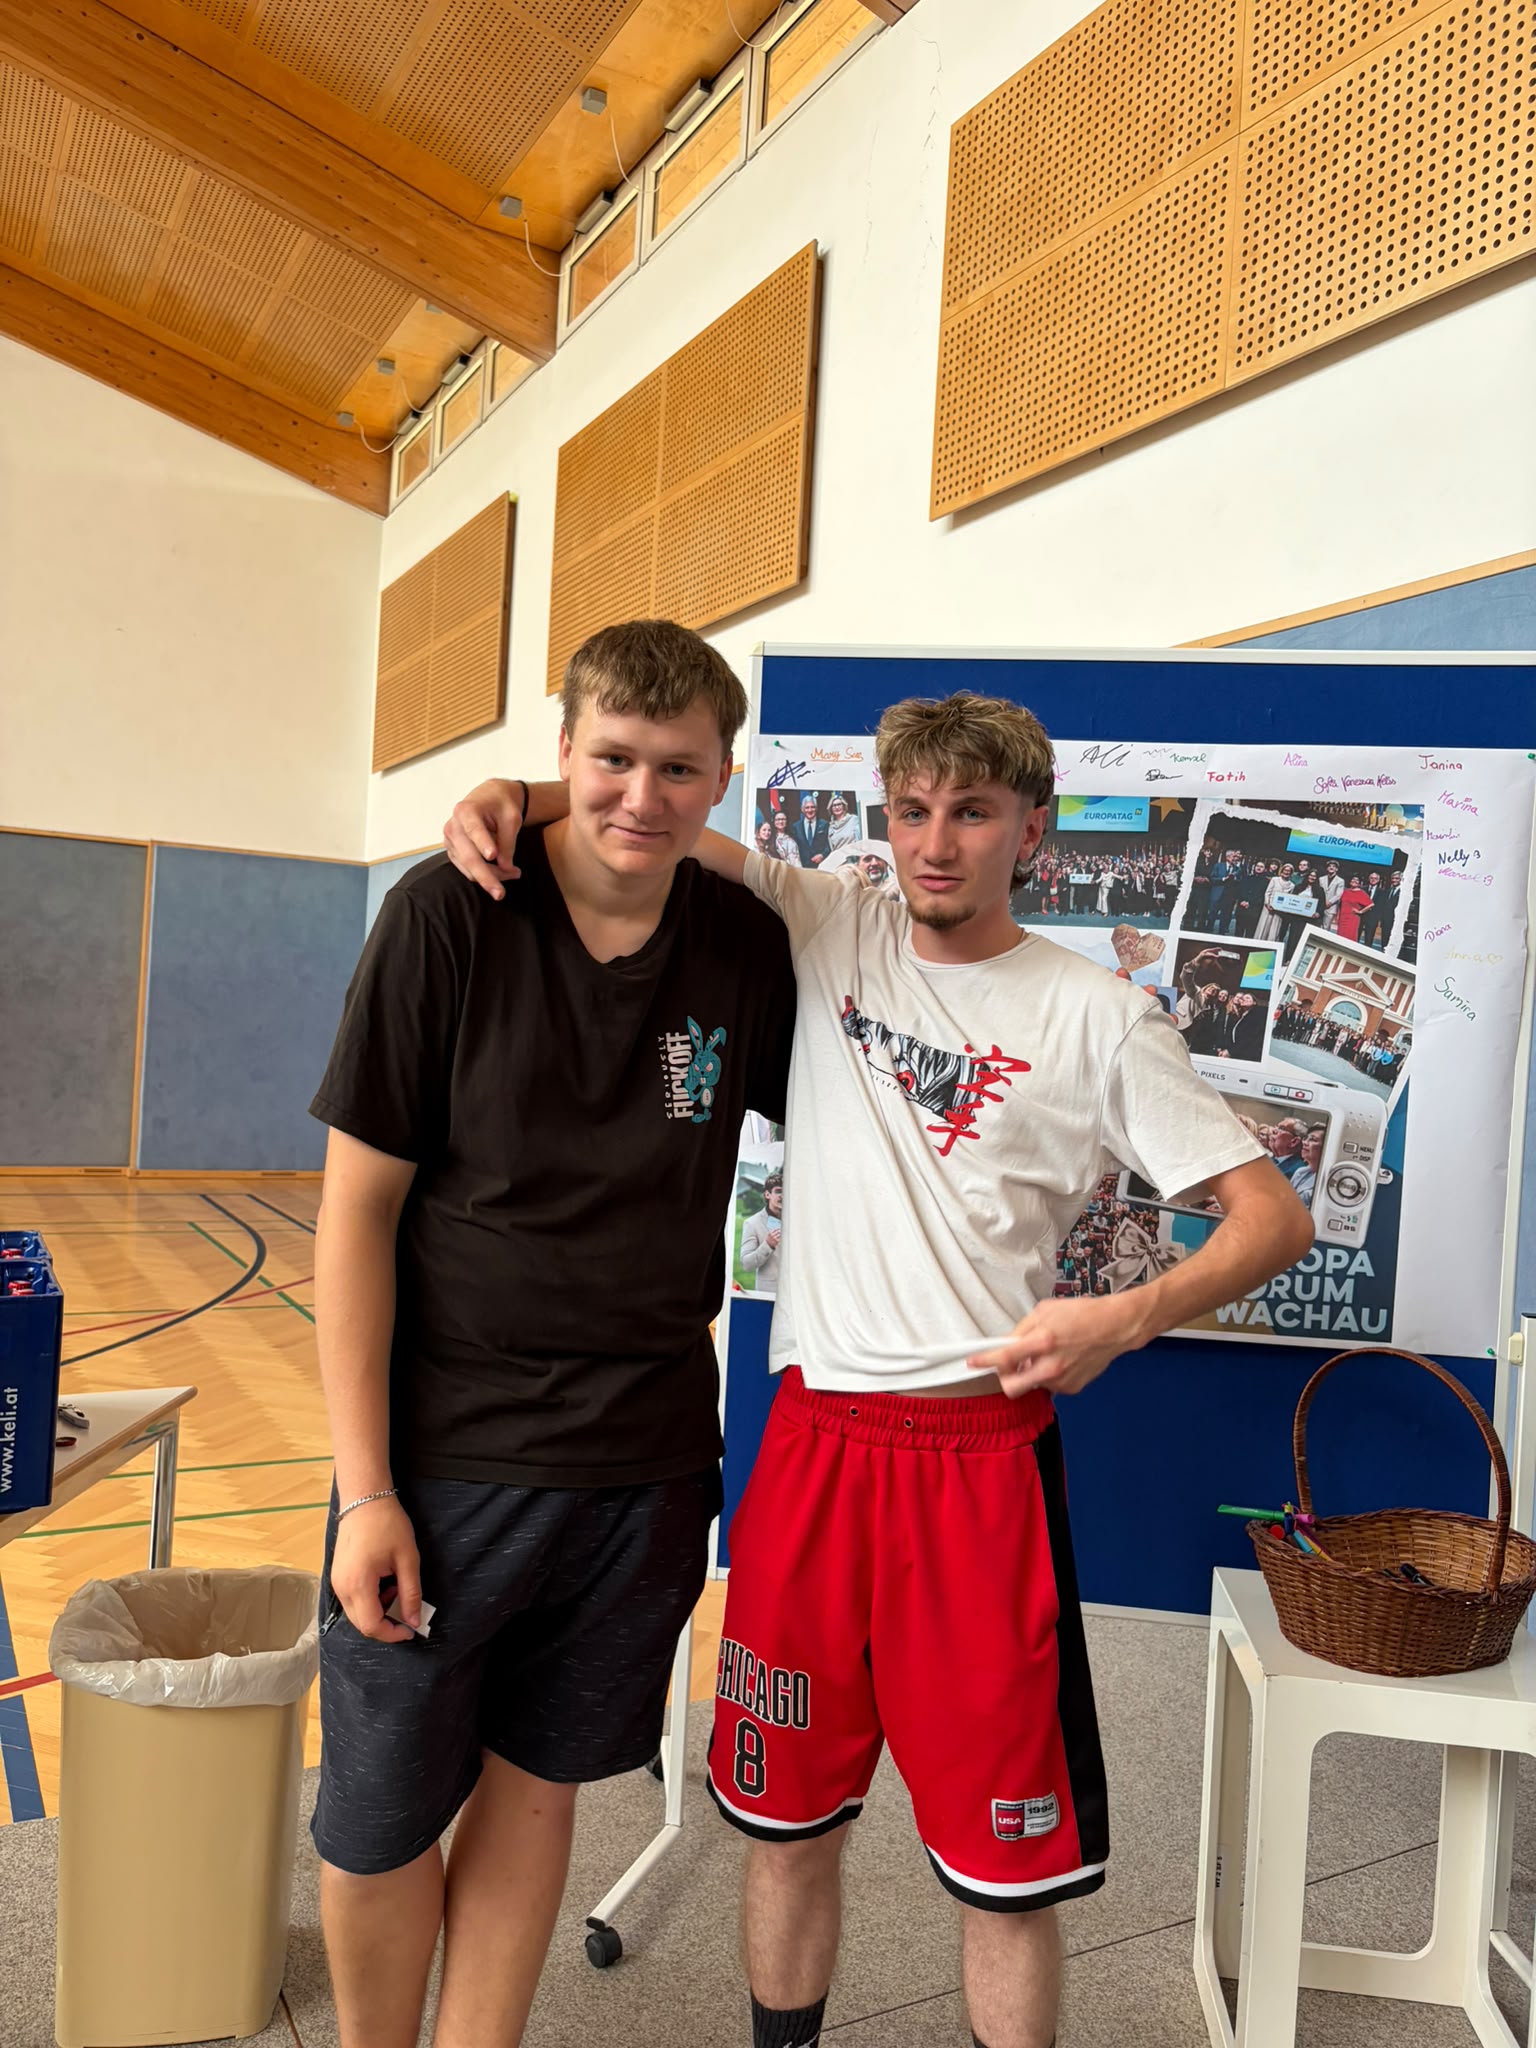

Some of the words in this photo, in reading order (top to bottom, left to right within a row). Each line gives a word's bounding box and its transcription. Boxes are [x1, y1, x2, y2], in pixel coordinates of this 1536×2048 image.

[1418, 754, 1463, 771] Janina
[1083, 812, 1134, 821] EUROPATAG
[1438, 789, 1480, 817] Marina
[1438, 848, 1471, 867] Nelly
[1434, 976, 1477, 1022] Samira
[658, 1036, 673, 1119] SERIOUSLY
[1200, 1070, 1226, 1081] PIXELS
[1284, 1246, 1375, 1277] OPA
[1215, 1300, 1388, 1334] WACHAU
[0, 1386, 18, 1493] www.keli.at
[733, 1717, 767, 1798] 8
[997, 1816, 1022, 1825] USA
[1026, 1801, 1055, 1815] 1992
